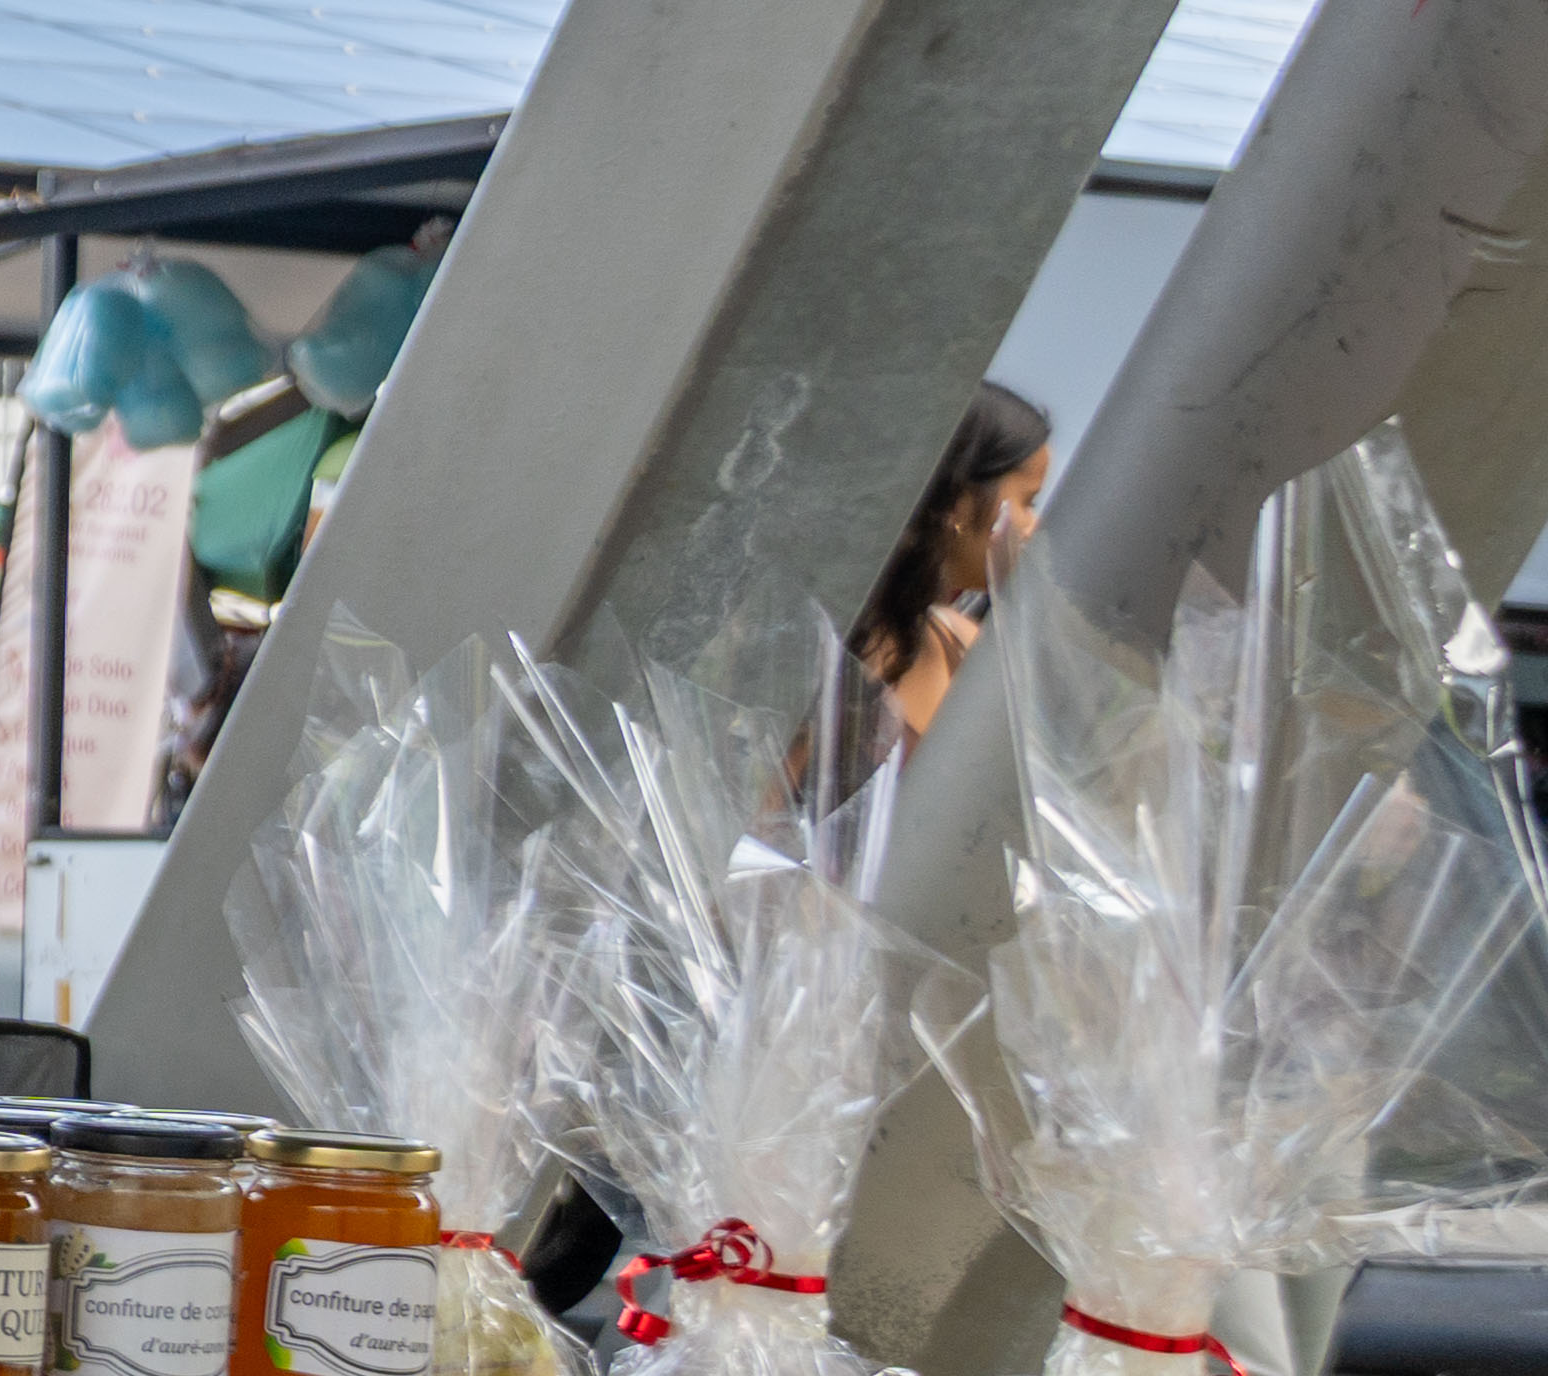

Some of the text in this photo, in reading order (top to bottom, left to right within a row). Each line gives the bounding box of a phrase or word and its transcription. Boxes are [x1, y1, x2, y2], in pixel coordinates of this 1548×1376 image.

[85, 1297, 174, 1322] confiture
[180, 1300, 203, 1321] de
[290, 1286, 384, 1316] confiture
[388, 1295, 411, 1317] de
